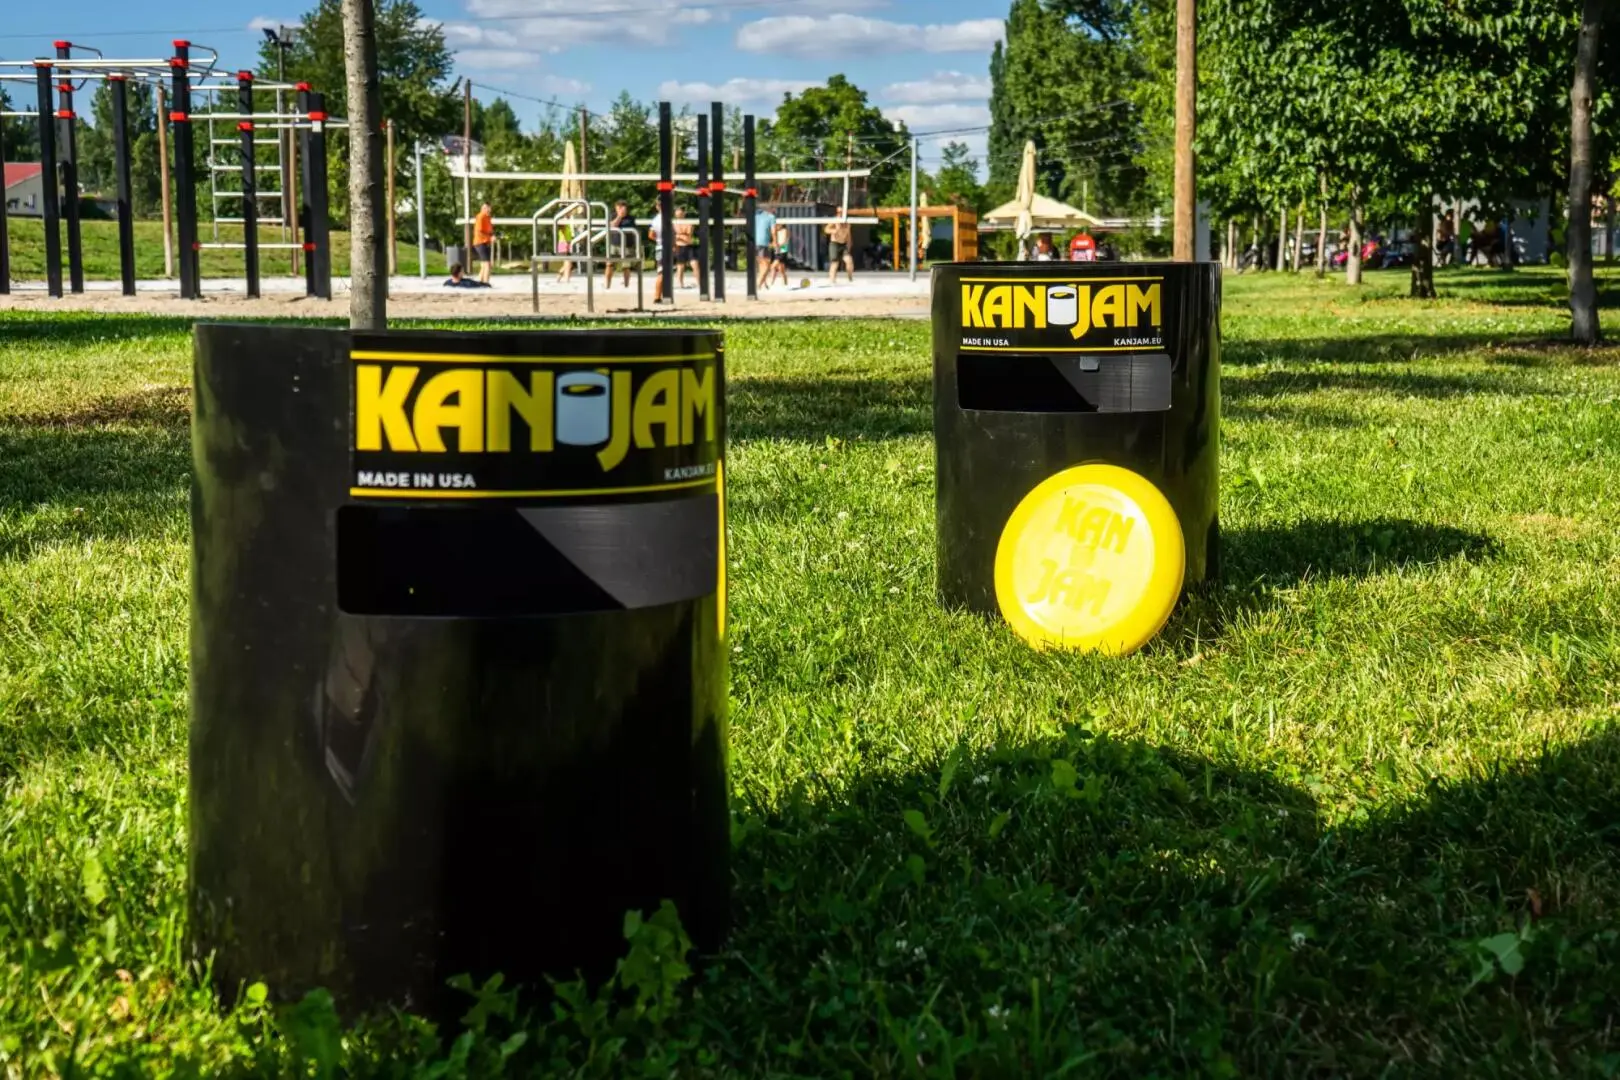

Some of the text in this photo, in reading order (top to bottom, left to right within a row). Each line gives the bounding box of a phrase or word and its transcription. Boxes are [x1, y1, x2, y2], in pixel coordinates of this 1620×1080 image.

[961, 283, 1162, 340] KAN JAM
[962, 337, 1009, 346] MADE IN USA
[1113, 337, 1162, 346] KANJAM.EU
[356, 364, 715, 472] KAN JAM
[358, 470, 477, 488] MADE IN USA
[1054, 495, 1136, 555] KAN
[1027, 557, 1112, 618] JAM
